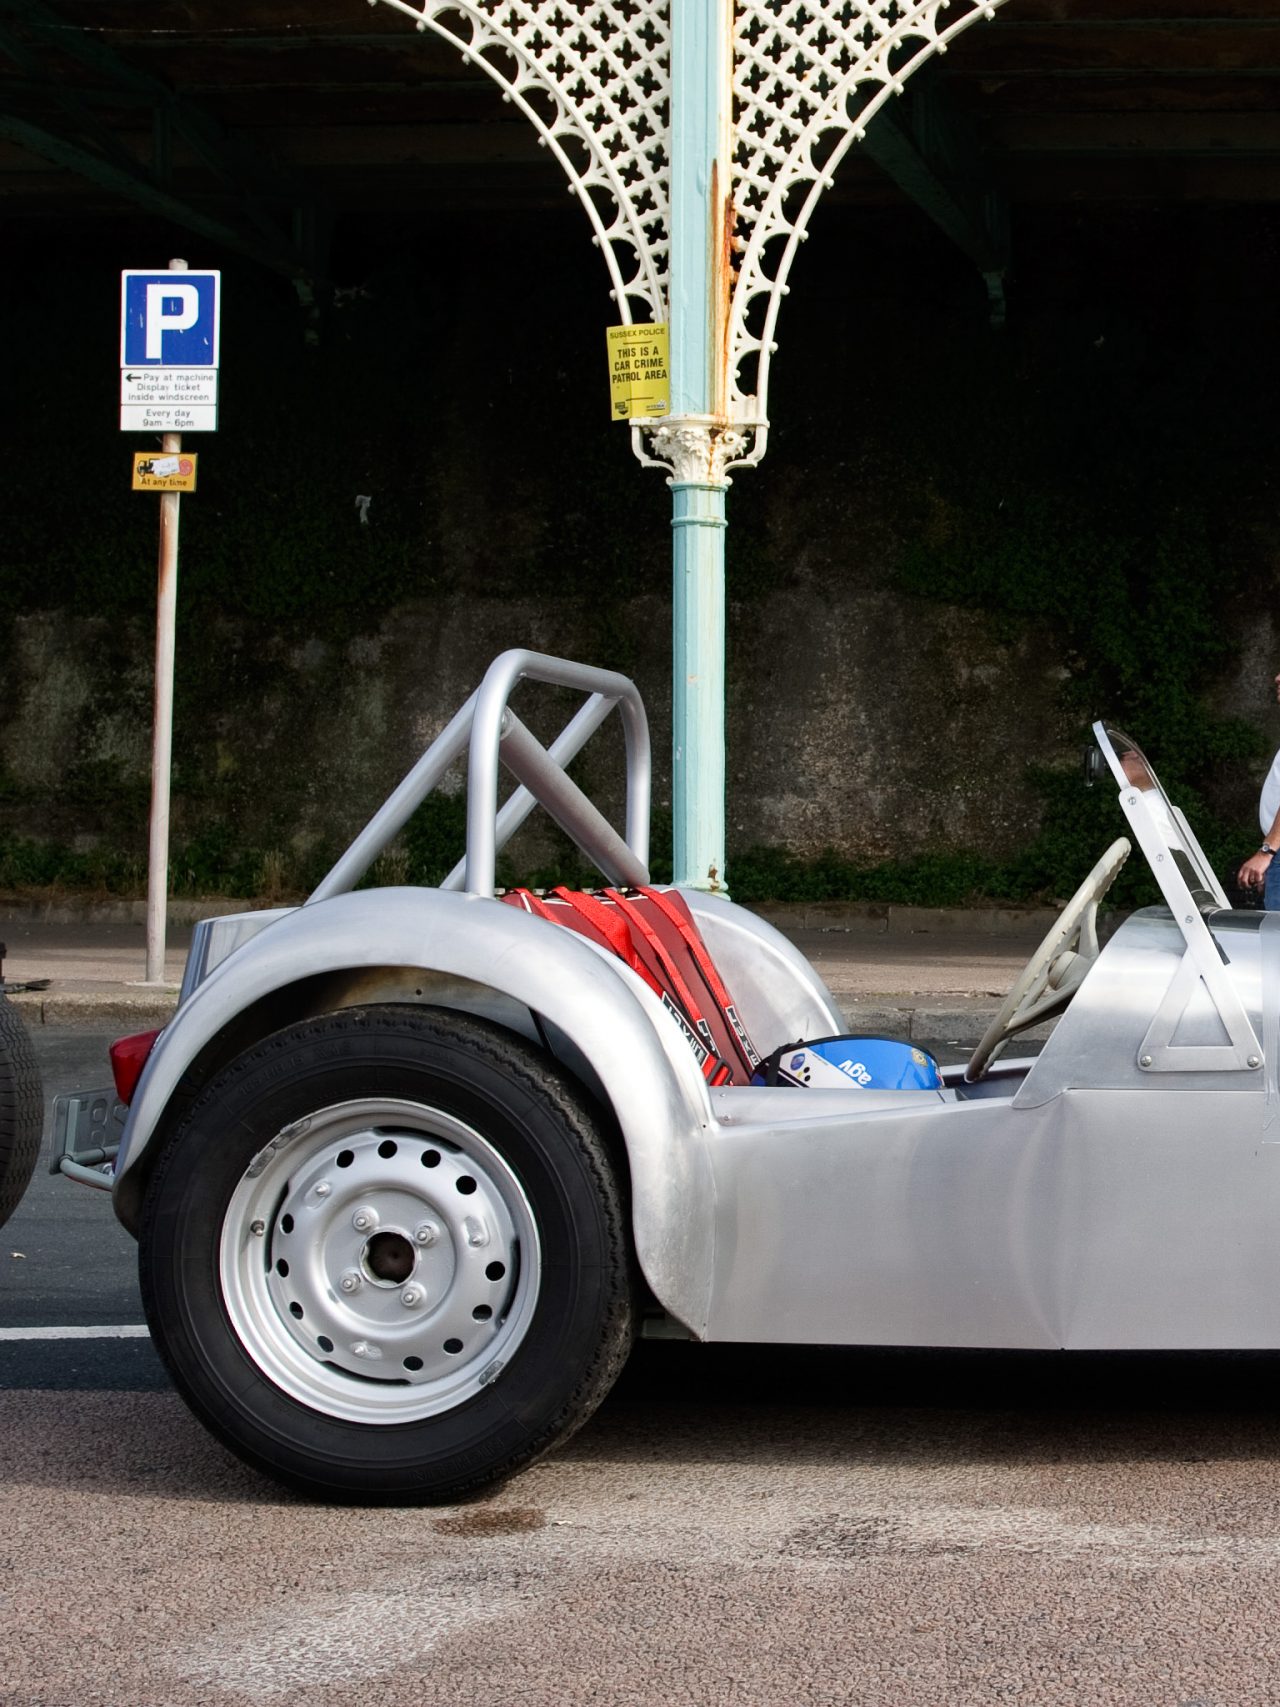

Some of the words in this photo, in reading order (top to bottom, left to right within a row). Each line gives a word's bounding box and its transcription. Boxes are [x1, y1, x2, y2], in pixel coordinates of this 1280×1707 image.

[146, 284, 199, 359] P
[610, 330, 637, 339] SUSSEX
[639, 328, 665, 337] POLICE
[617, 347, 636, 359] THIS
[640, 346, 649, 357] IS
[652, 346, 659, 355] A
[614, 360, 631, 371] CAR
[634, 358, 663, 369] CRIME
[143, 373, 160, 382] Pay
[163, 373, 172, 381] at
[176, 373, 214, 381] machine
[612, 371, 641, 383] PATROL
[644, 369, 668, 380] AREA
[174, 383, 201, 391] ticket
[158, 393, 209, 401] windscreen
[146, 409, 171, 418] Every
[174, 409, 191, 418] day
[142, 418, 162, 427] 9am
[174, 418, 195, 428] 6pm
[153, 479, 168, 487] any
[838, 1059, 873, 1085] agv
